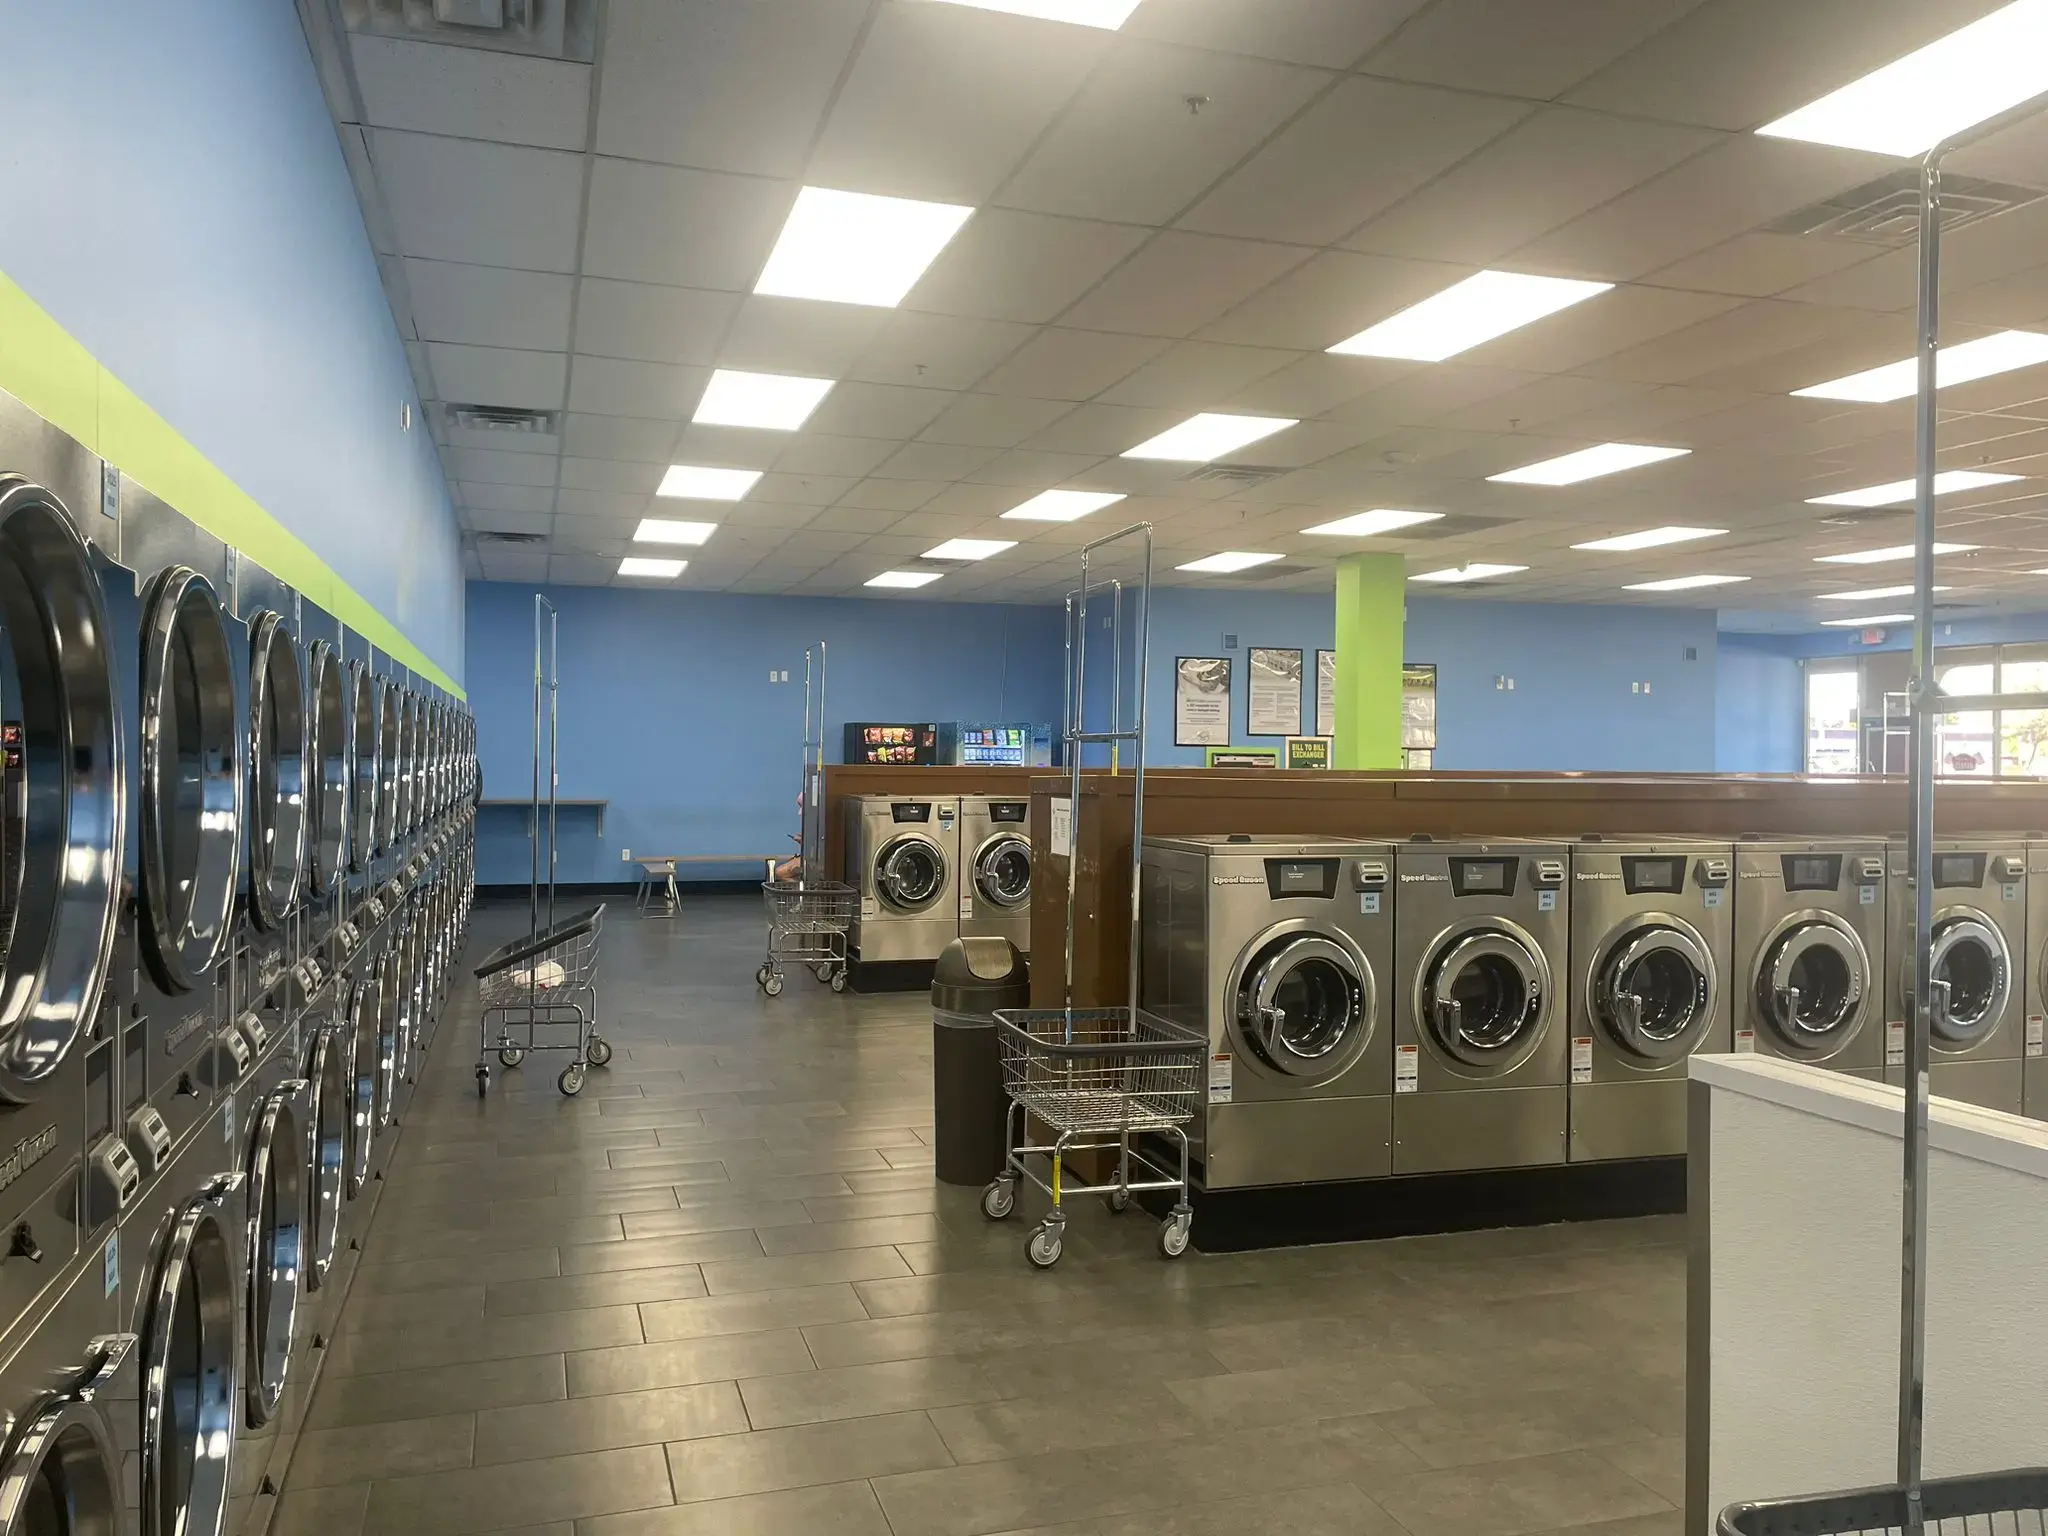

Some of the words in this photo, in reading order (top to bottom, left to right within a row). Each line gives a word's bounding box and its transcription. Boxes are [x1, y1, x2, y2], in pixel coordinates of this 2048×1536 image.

[1292, 743, 1304, 751] BILL
[1304, 743, 1313, 751] TO
[1313, 743, 1326, 751] BILL
[1213, 876, 1239, 885] Speed
[1400, 874, 1424, 883] Speed
[1576, 872, 1598, 881] Speed
